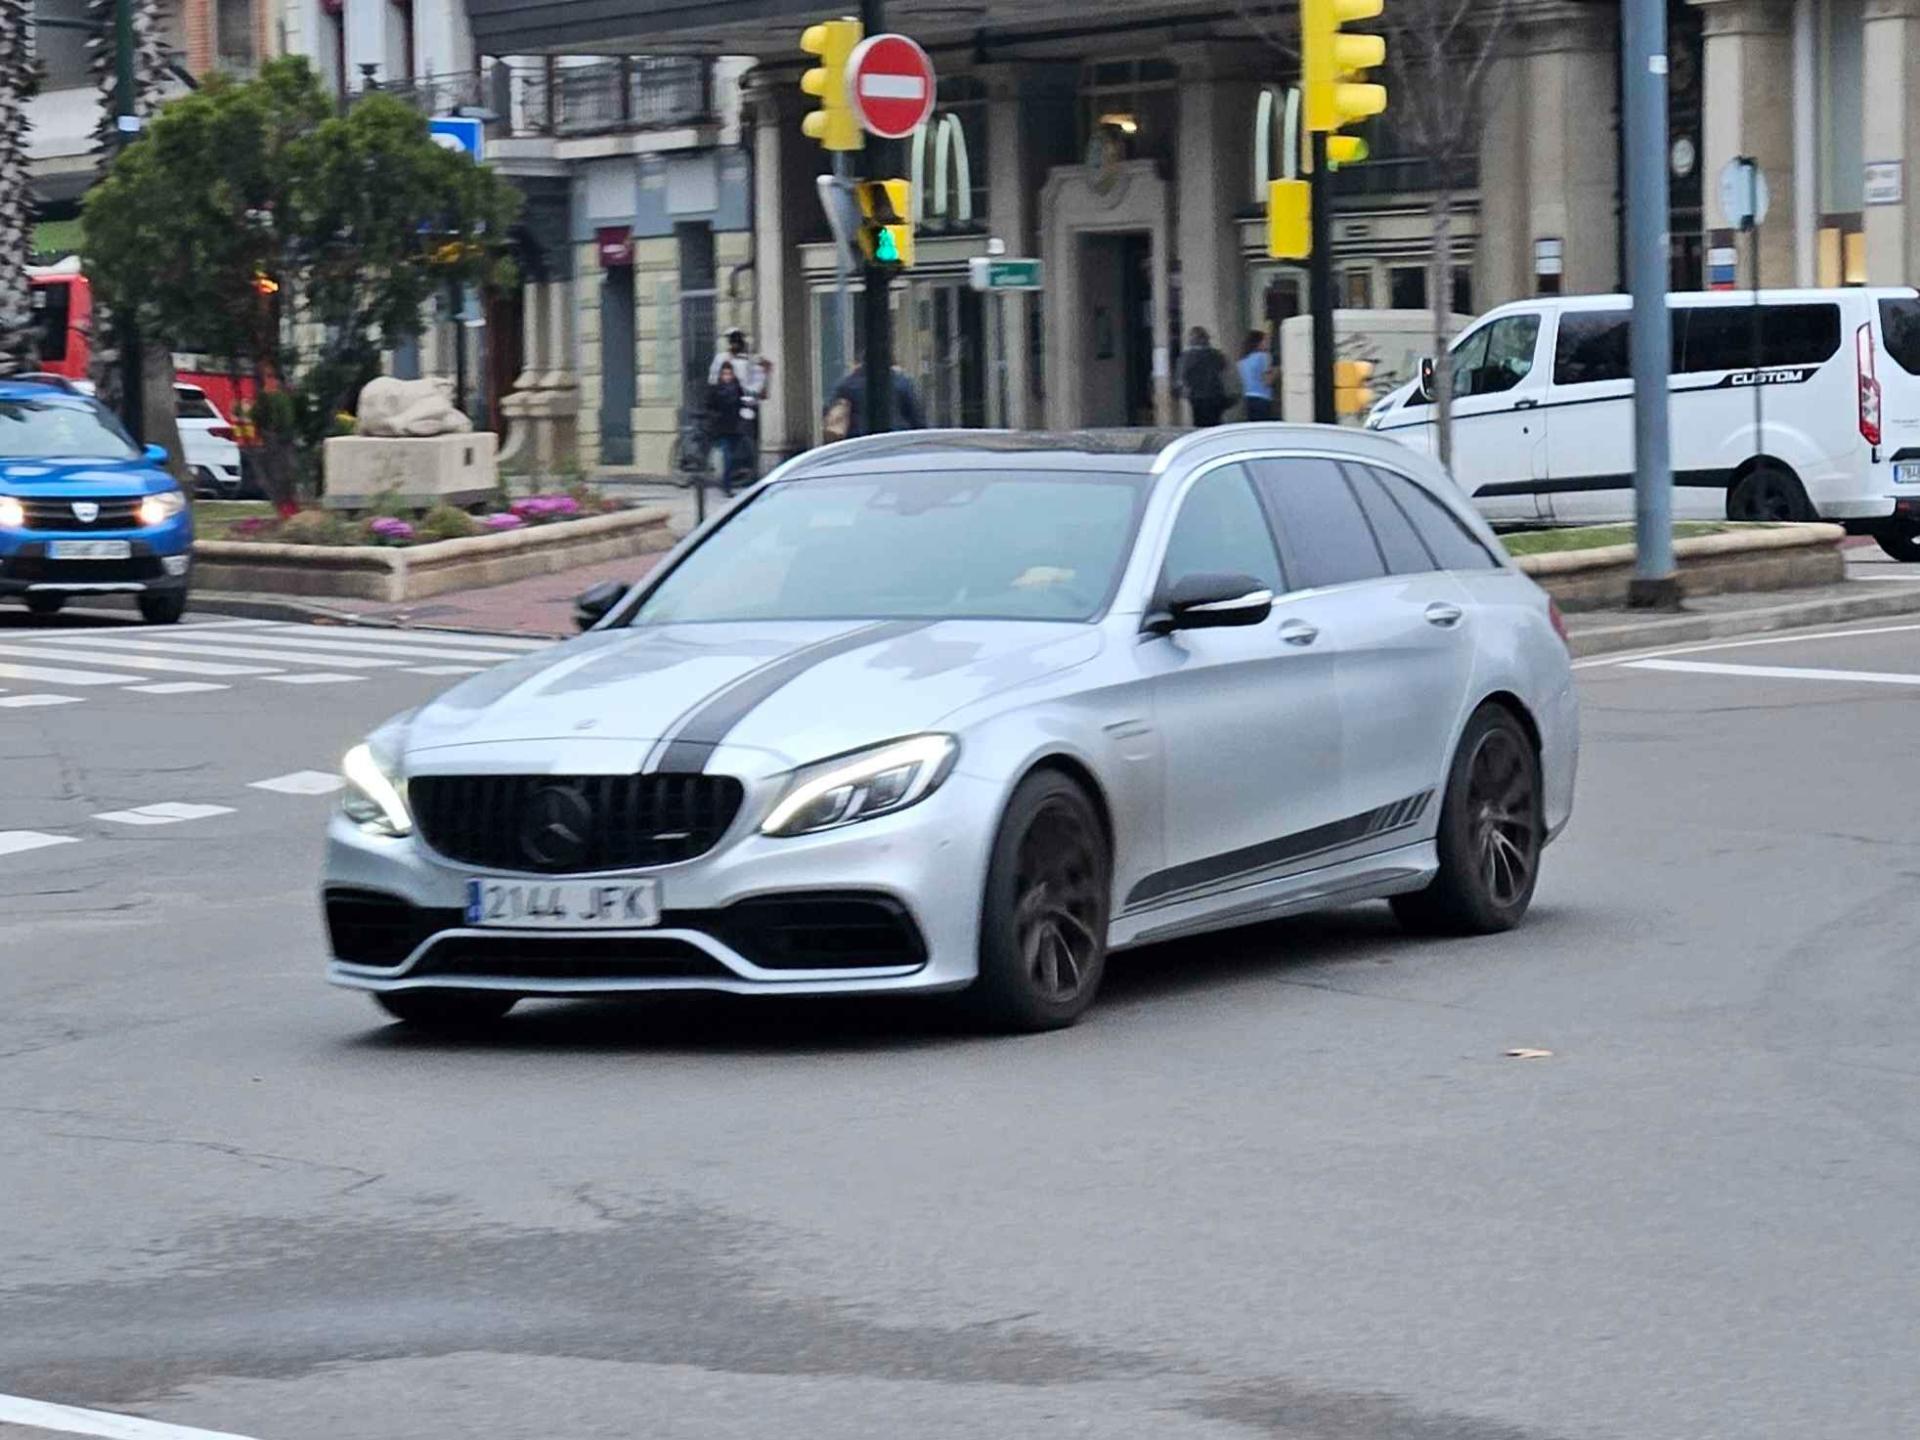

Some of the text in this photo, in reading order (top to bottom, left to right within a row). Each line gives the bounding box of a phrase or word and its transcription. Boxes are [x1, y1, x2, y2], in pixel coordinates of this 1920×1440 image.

[1731, 370, 1803, 385] CUSTOM
[486, 886, 646, 920] 2144 JFK
